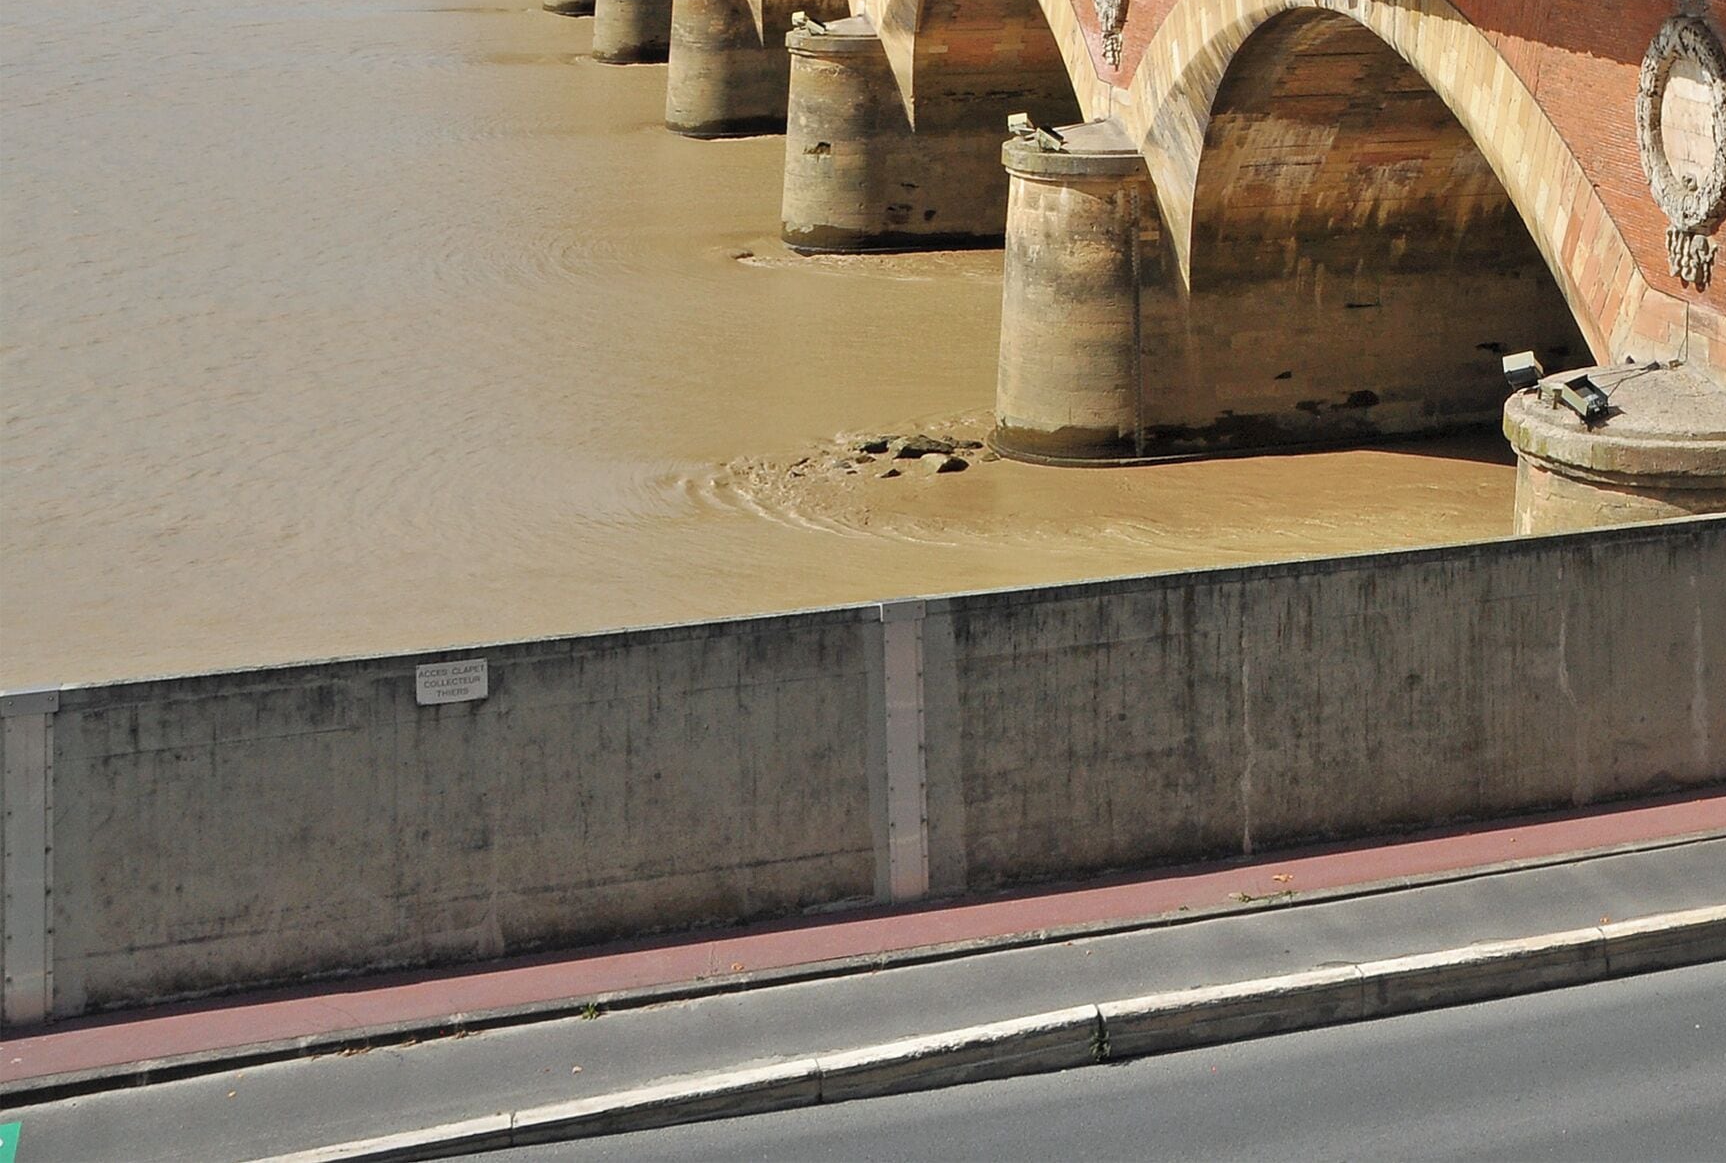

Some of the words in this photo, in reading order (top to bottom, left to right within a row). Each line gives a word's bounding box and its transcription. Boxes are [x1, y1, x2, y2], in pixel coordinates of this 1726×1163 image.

[418, 668, 448, 678] ACCES
[451, 664, 484, 675] CLAPET
[423, 675, 481, 688] COLLECTEUR
[436, 688, 469, 697] THIERS
